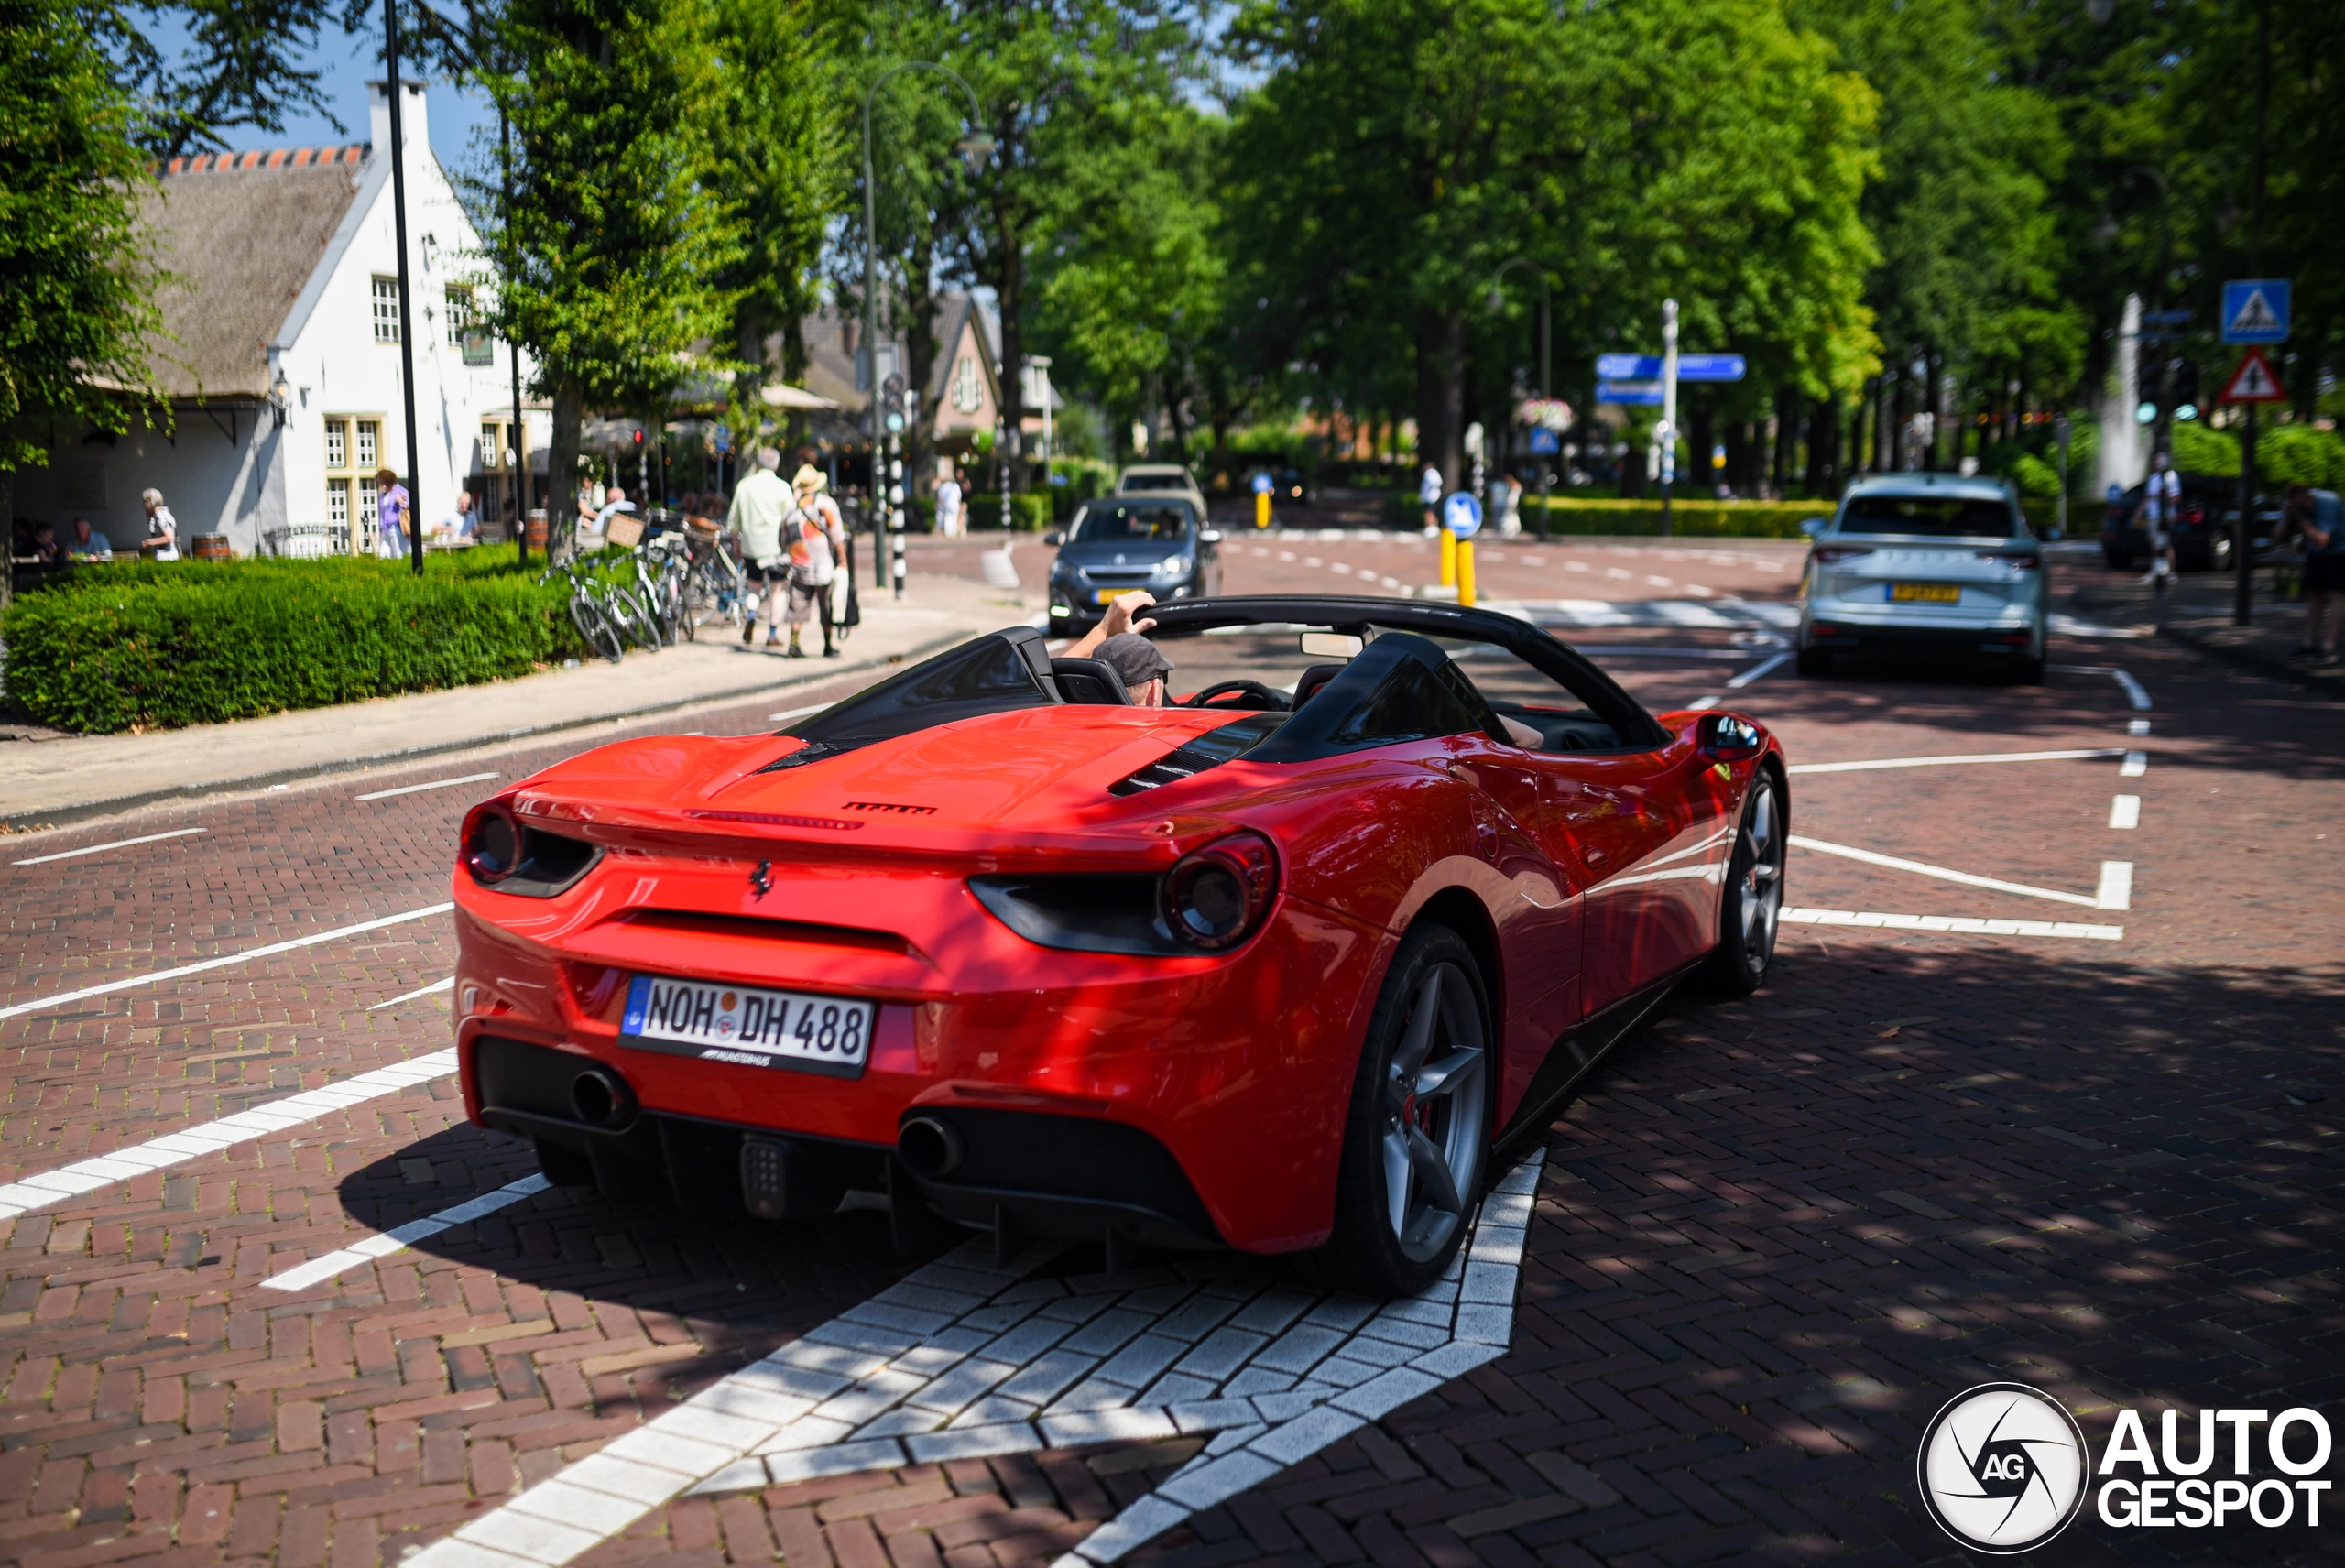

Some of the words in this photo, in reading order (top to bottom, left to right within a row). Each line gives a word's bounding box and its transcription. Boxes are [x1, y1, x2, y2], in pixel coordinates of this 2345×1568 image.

[648, 984, 717, 1036] NOH
[739, 996, 789, 1046] DH
[795, 1002, 863, 1055] 488
